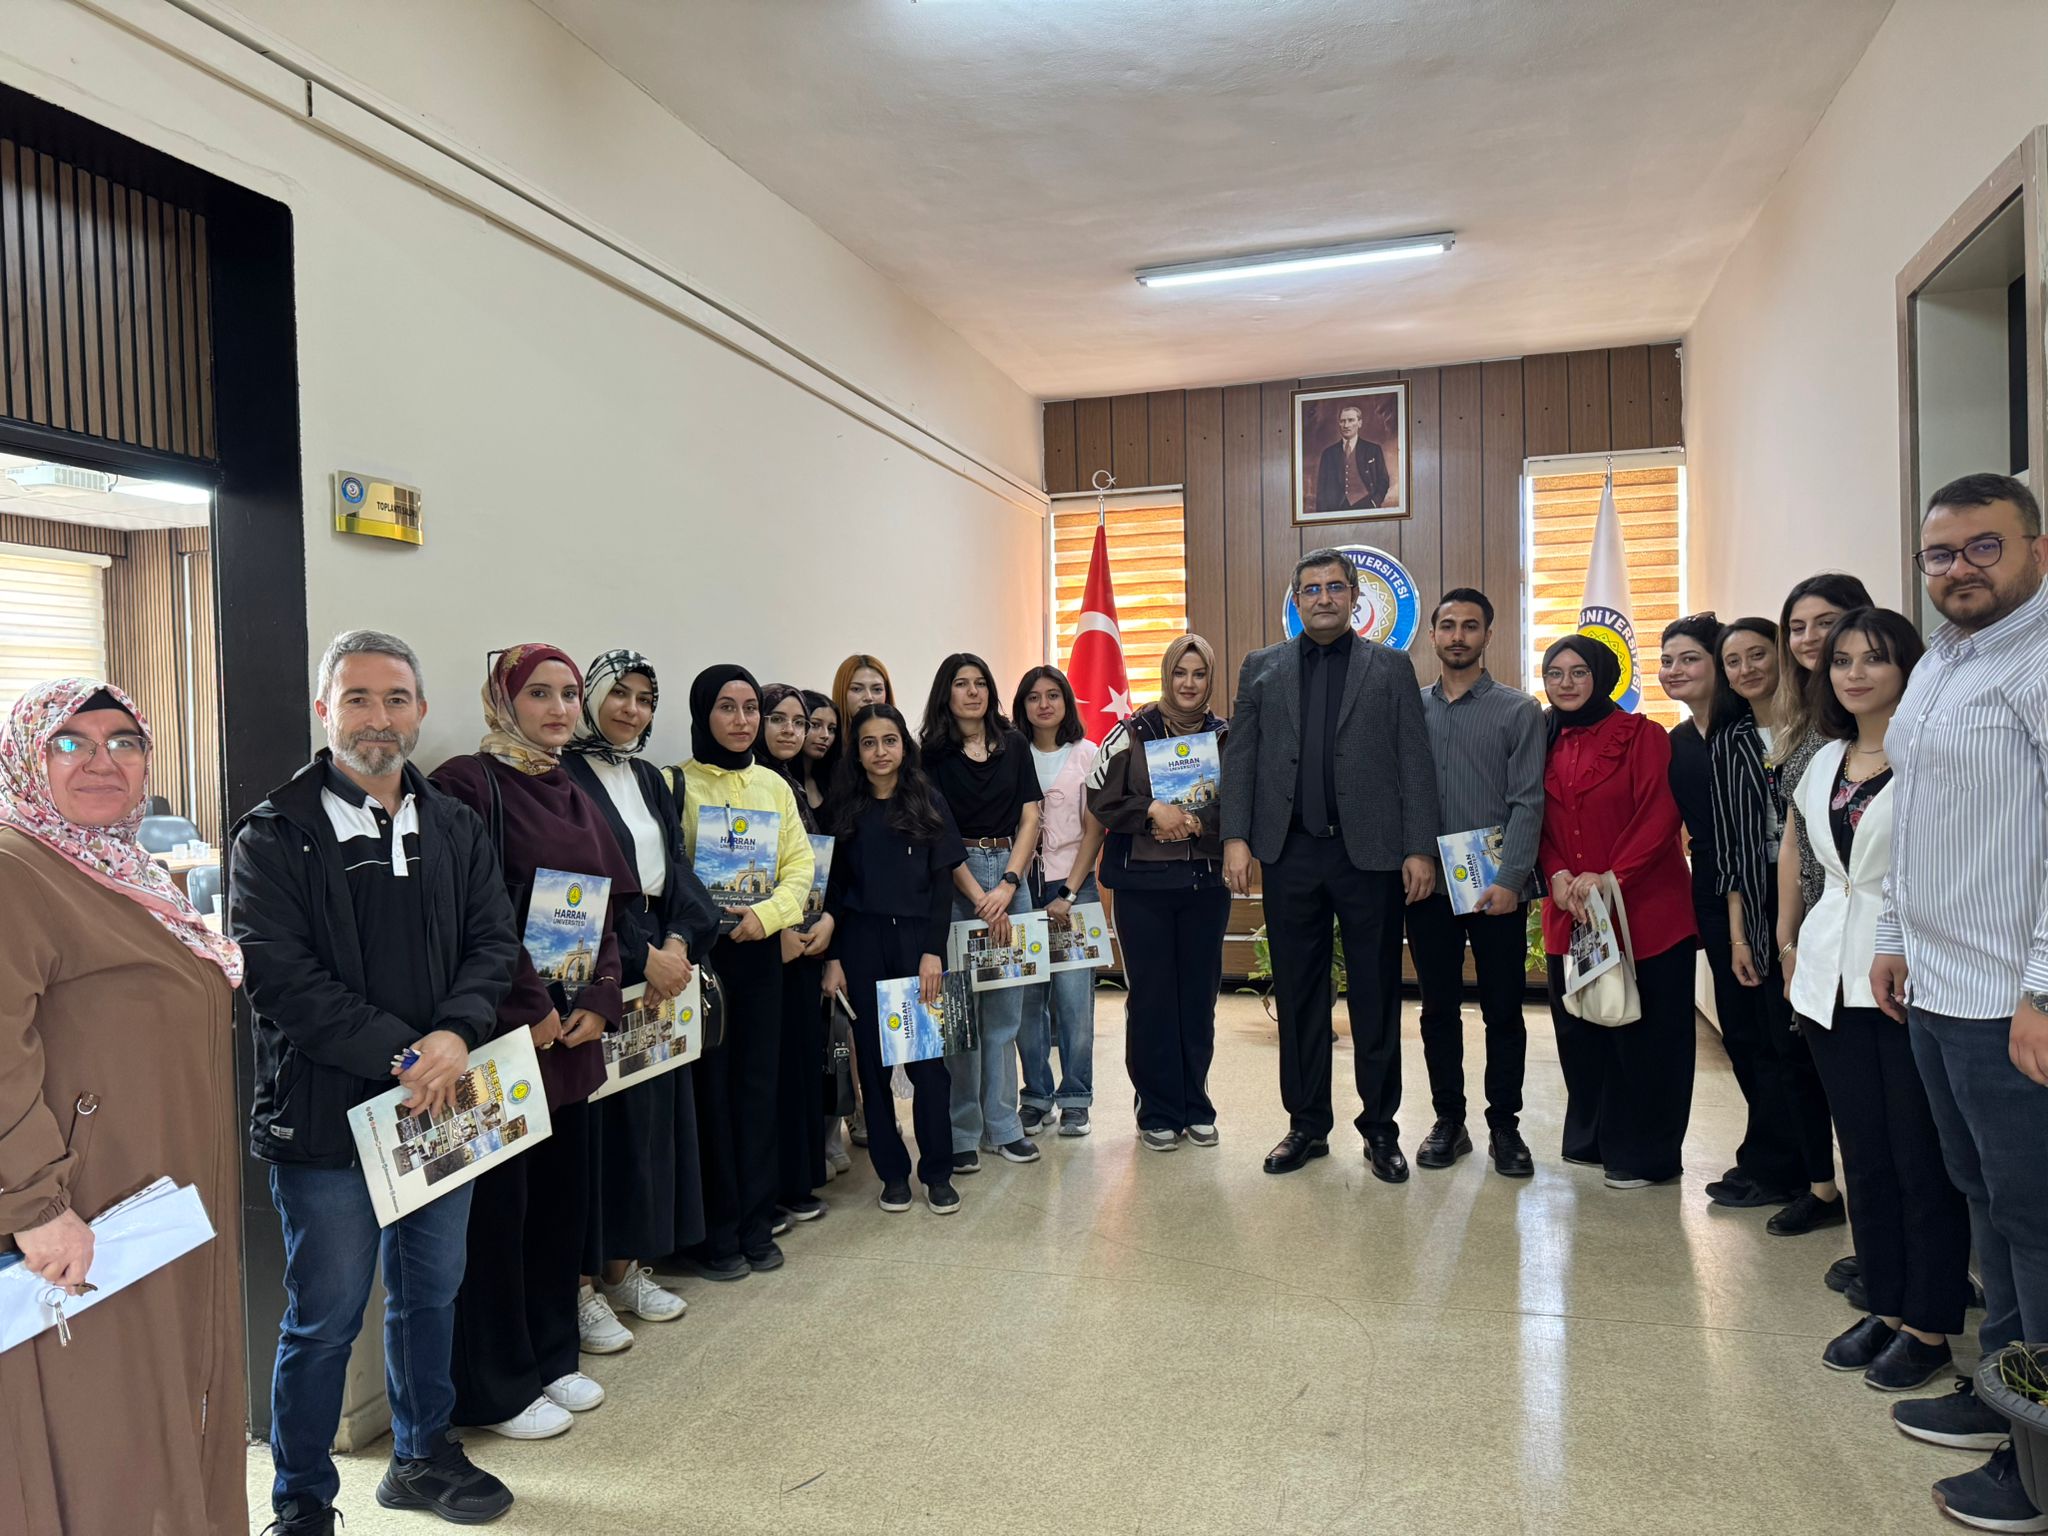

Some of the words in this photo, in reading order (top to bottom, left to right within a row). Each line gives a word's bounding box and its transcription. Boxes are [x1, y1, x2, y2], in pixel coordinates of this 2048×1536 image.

[1345, 553, 1409, 599] NİVERSİTESİ
[1168, 757, 1200, 768] HARRAN
[1466, 854, 1479, 889] HARRAN
[554, 908, 587, 921] HARRAN
[901, 1001, 911, 1039] HARRAN
